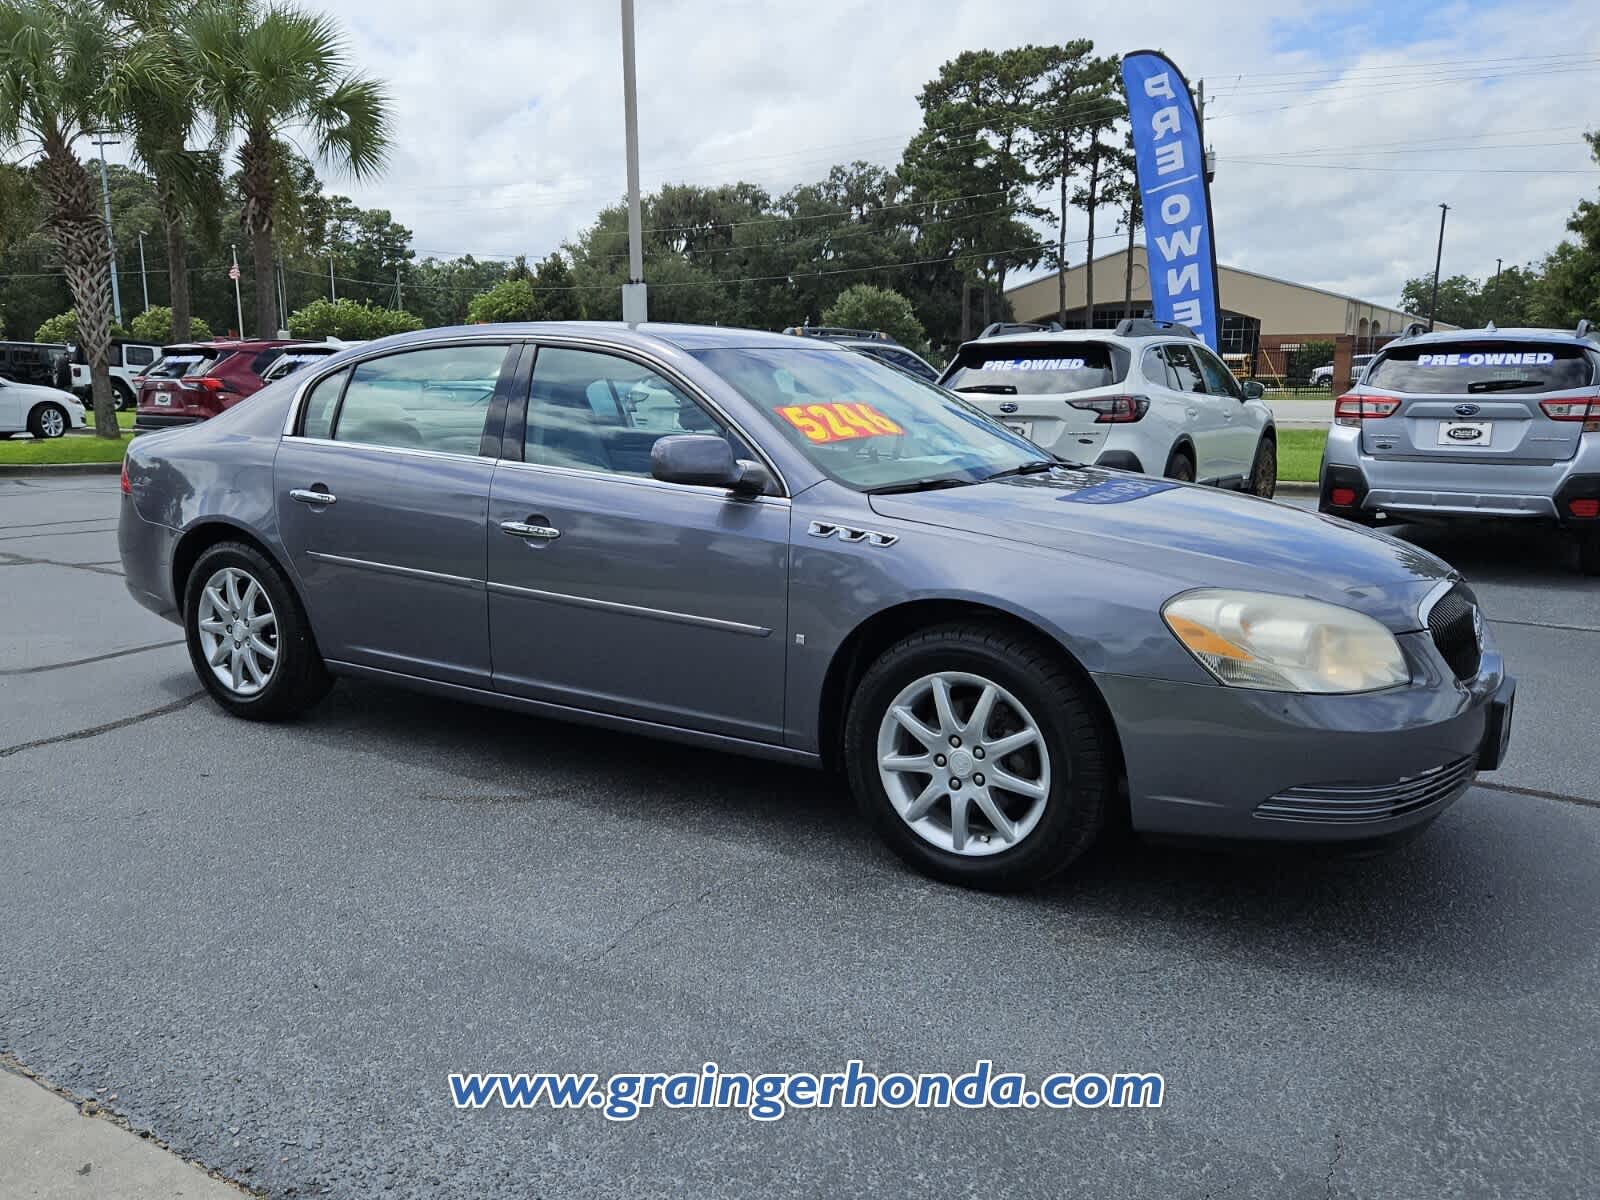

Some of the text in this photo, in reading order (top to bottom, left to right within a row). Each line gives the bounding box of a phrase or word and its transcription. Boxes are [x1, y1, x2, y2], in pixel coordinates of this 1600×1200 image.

[982, 358, 1084, 371] PRE-OWNED
[1417, 352, 1554, 367] PRE-OWNED
[782, 403, 899, 440] 5246
